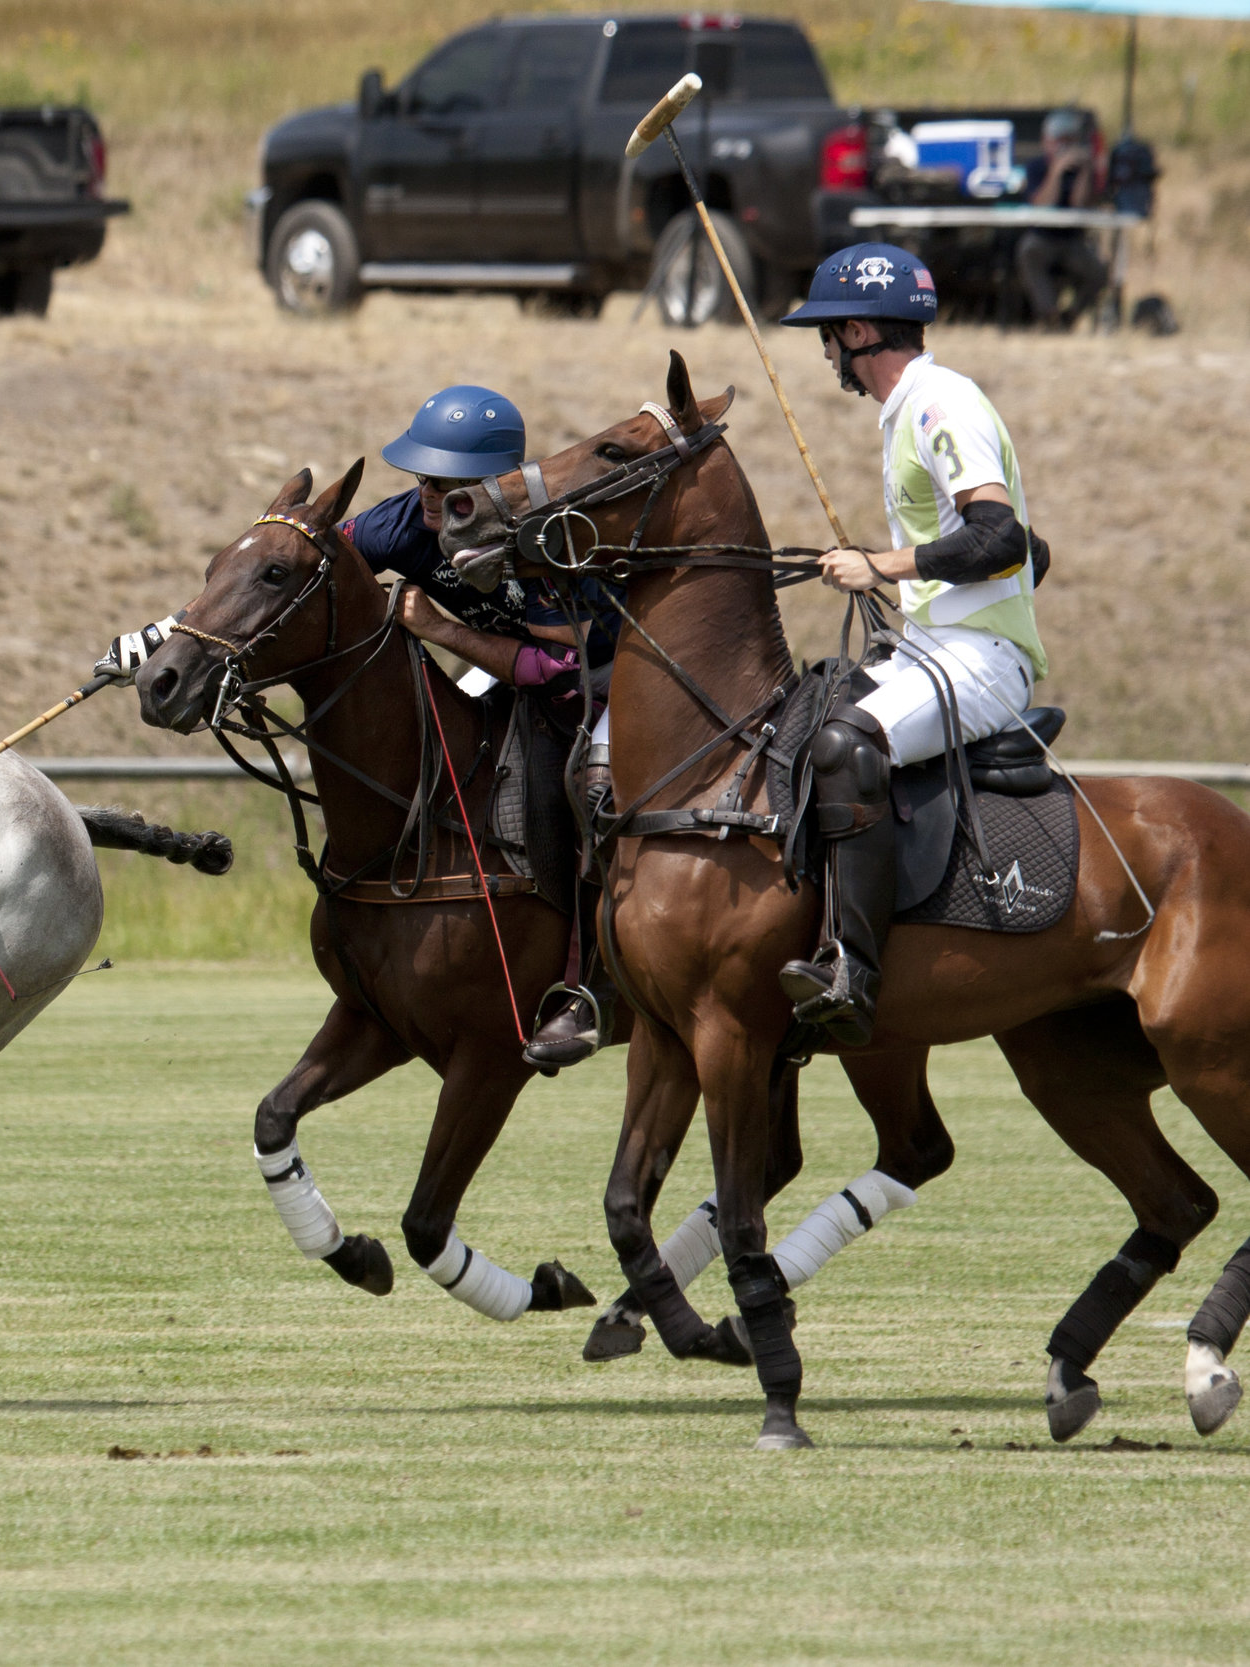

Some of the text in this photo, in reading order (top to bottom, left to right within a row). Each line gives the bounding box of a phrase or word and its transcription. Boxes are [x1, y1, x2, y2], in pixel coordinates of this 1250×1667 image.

[933, 429, 964, 480] 3
[1025, 885, 1054, 897] VALLEY
[1016, 902, 1037, 912] CLUB
